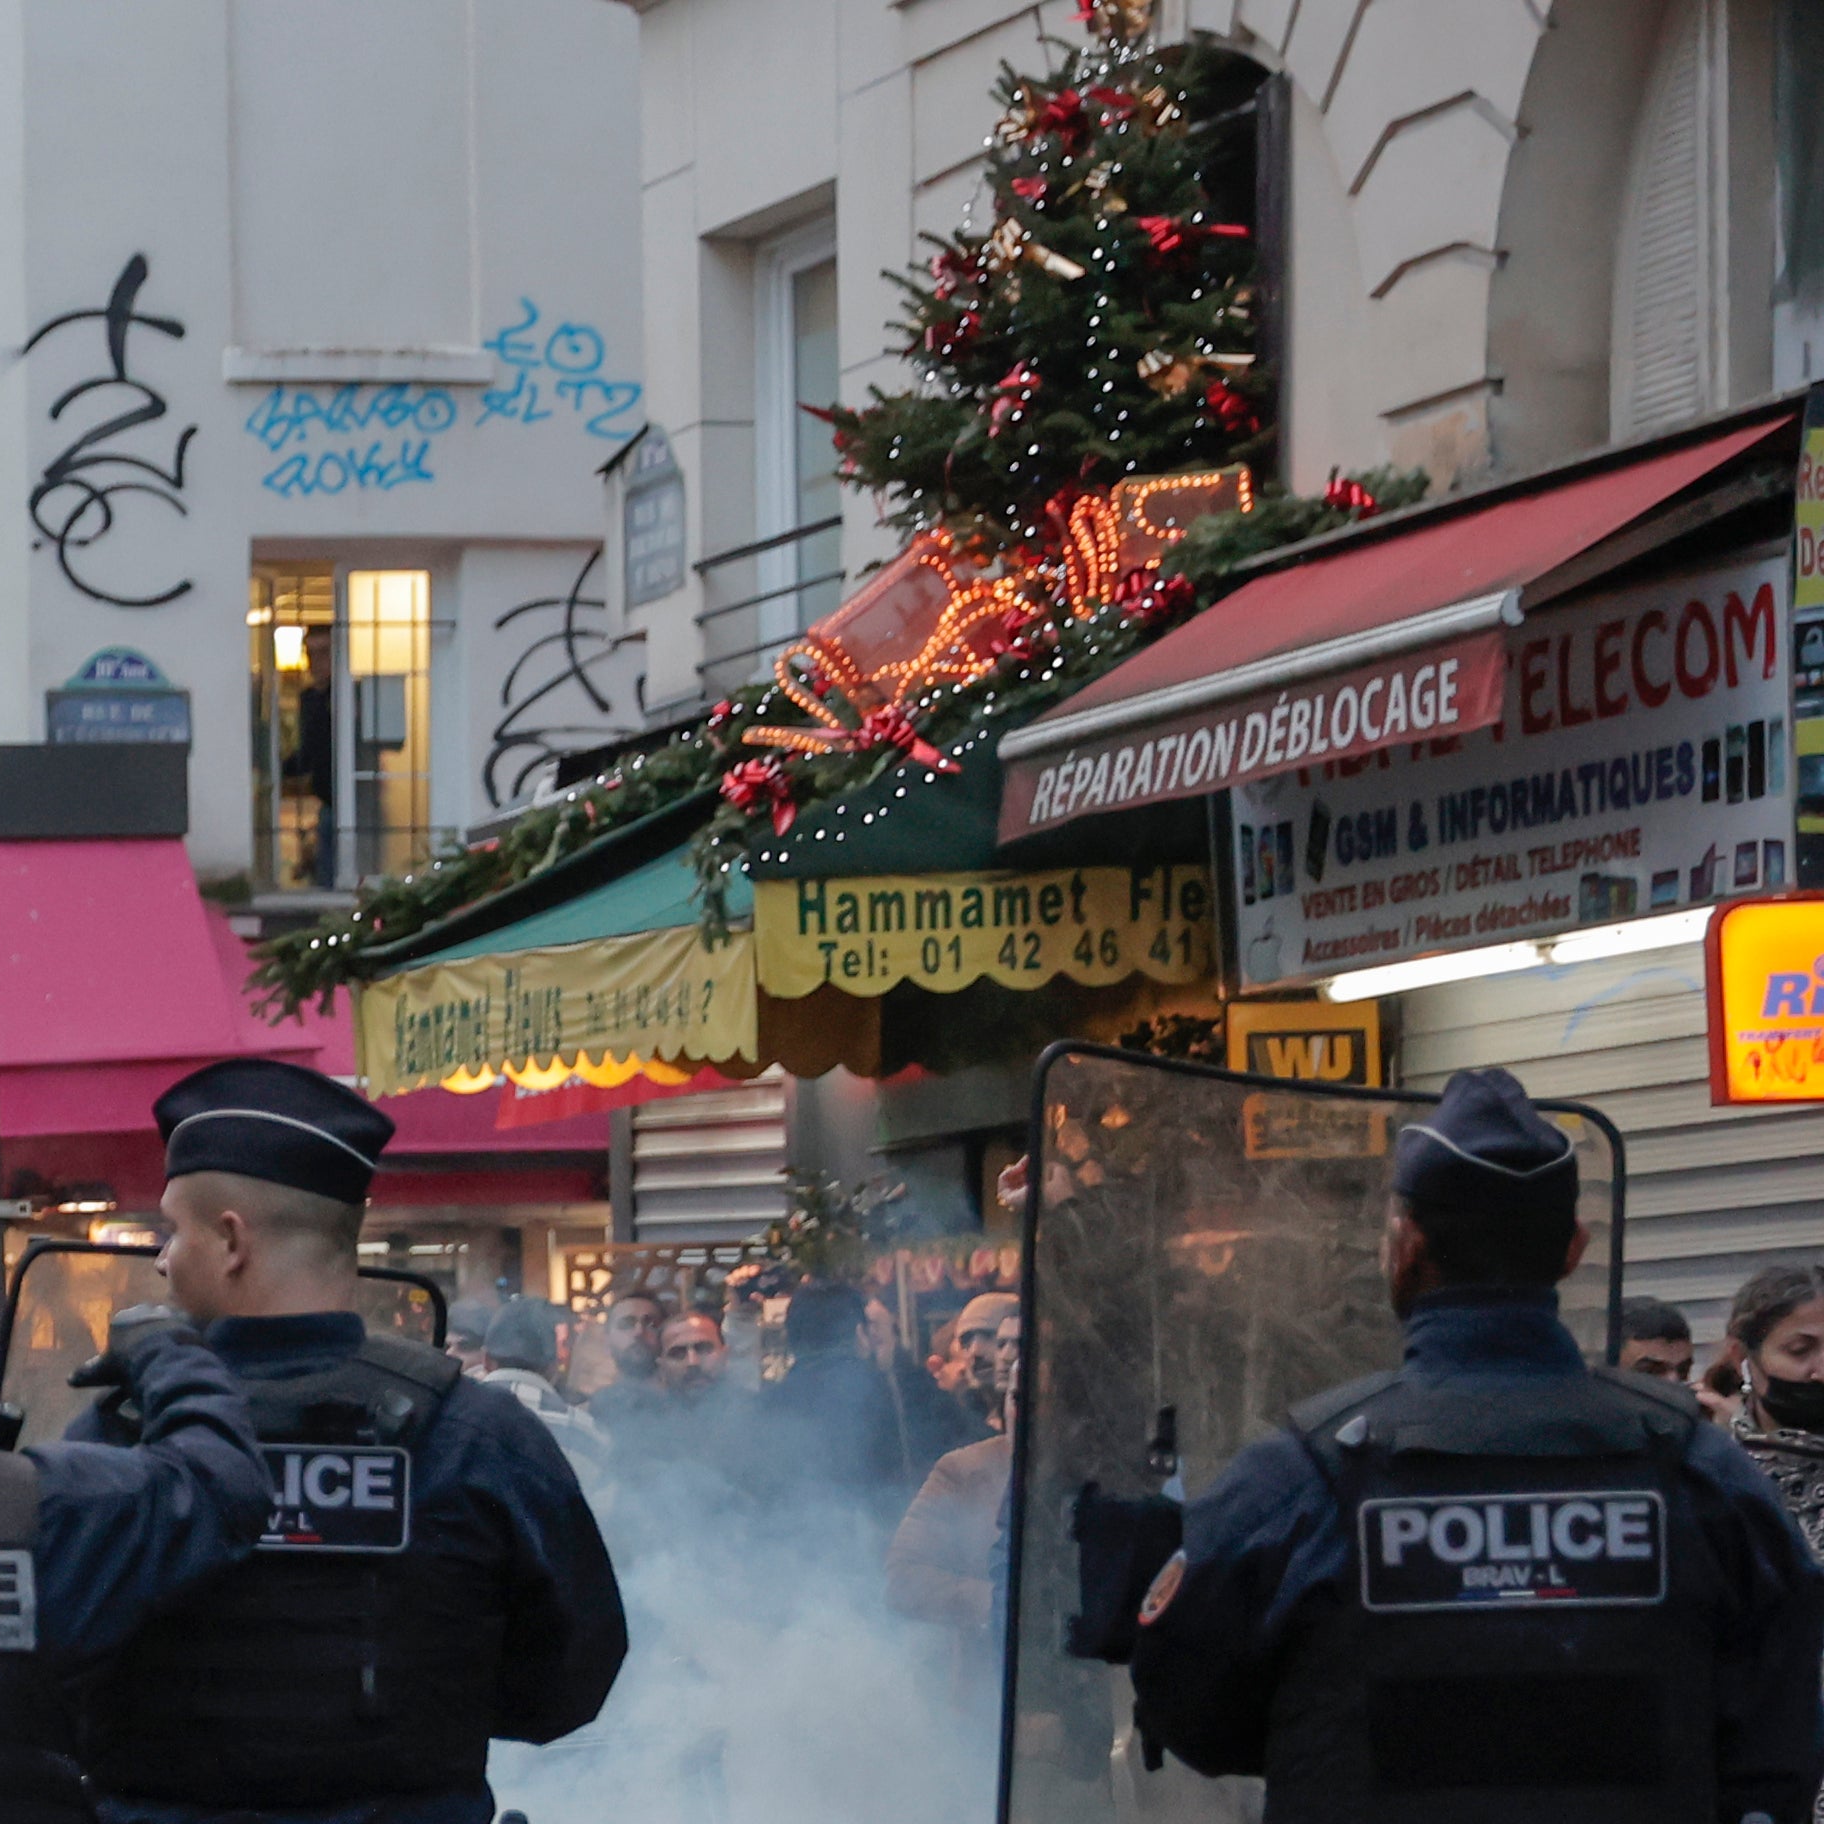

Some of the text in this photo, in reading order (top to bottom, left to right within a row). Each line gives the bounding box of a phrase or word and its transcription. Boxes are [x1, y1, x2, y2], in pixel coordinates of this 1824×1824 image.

[1493, 582, 1776, 741] ELECOM
[1028, 717, 1239, 825] RÉPARATION
[1238, 658, 1459, 770] DÉBLOCAGE
[1334, 807, 1398, 867] GSM
[1406, 802, 1430, 852] &
[1438, 741, 1695, 845] INFORMATIQUES
[796, 867, 1087, 935] Hammamet
[1301, 885, 1357, 920] VENTE
[1362, 879, 1386, 911] EN
[1389, 868, 1441, 905] GROS
[1455, 852, 1522, 892] DÉTAIL
[1527, 827, 1642, 875] TELEPHONE
[818, 927, 1191, 980] Tel: 01 42 46 41
[1266, 1035, 1353, 1081] WU
[273, 1453, 395, 1509] ICE
[1379, 1500, 1653, 1566] POLICE
